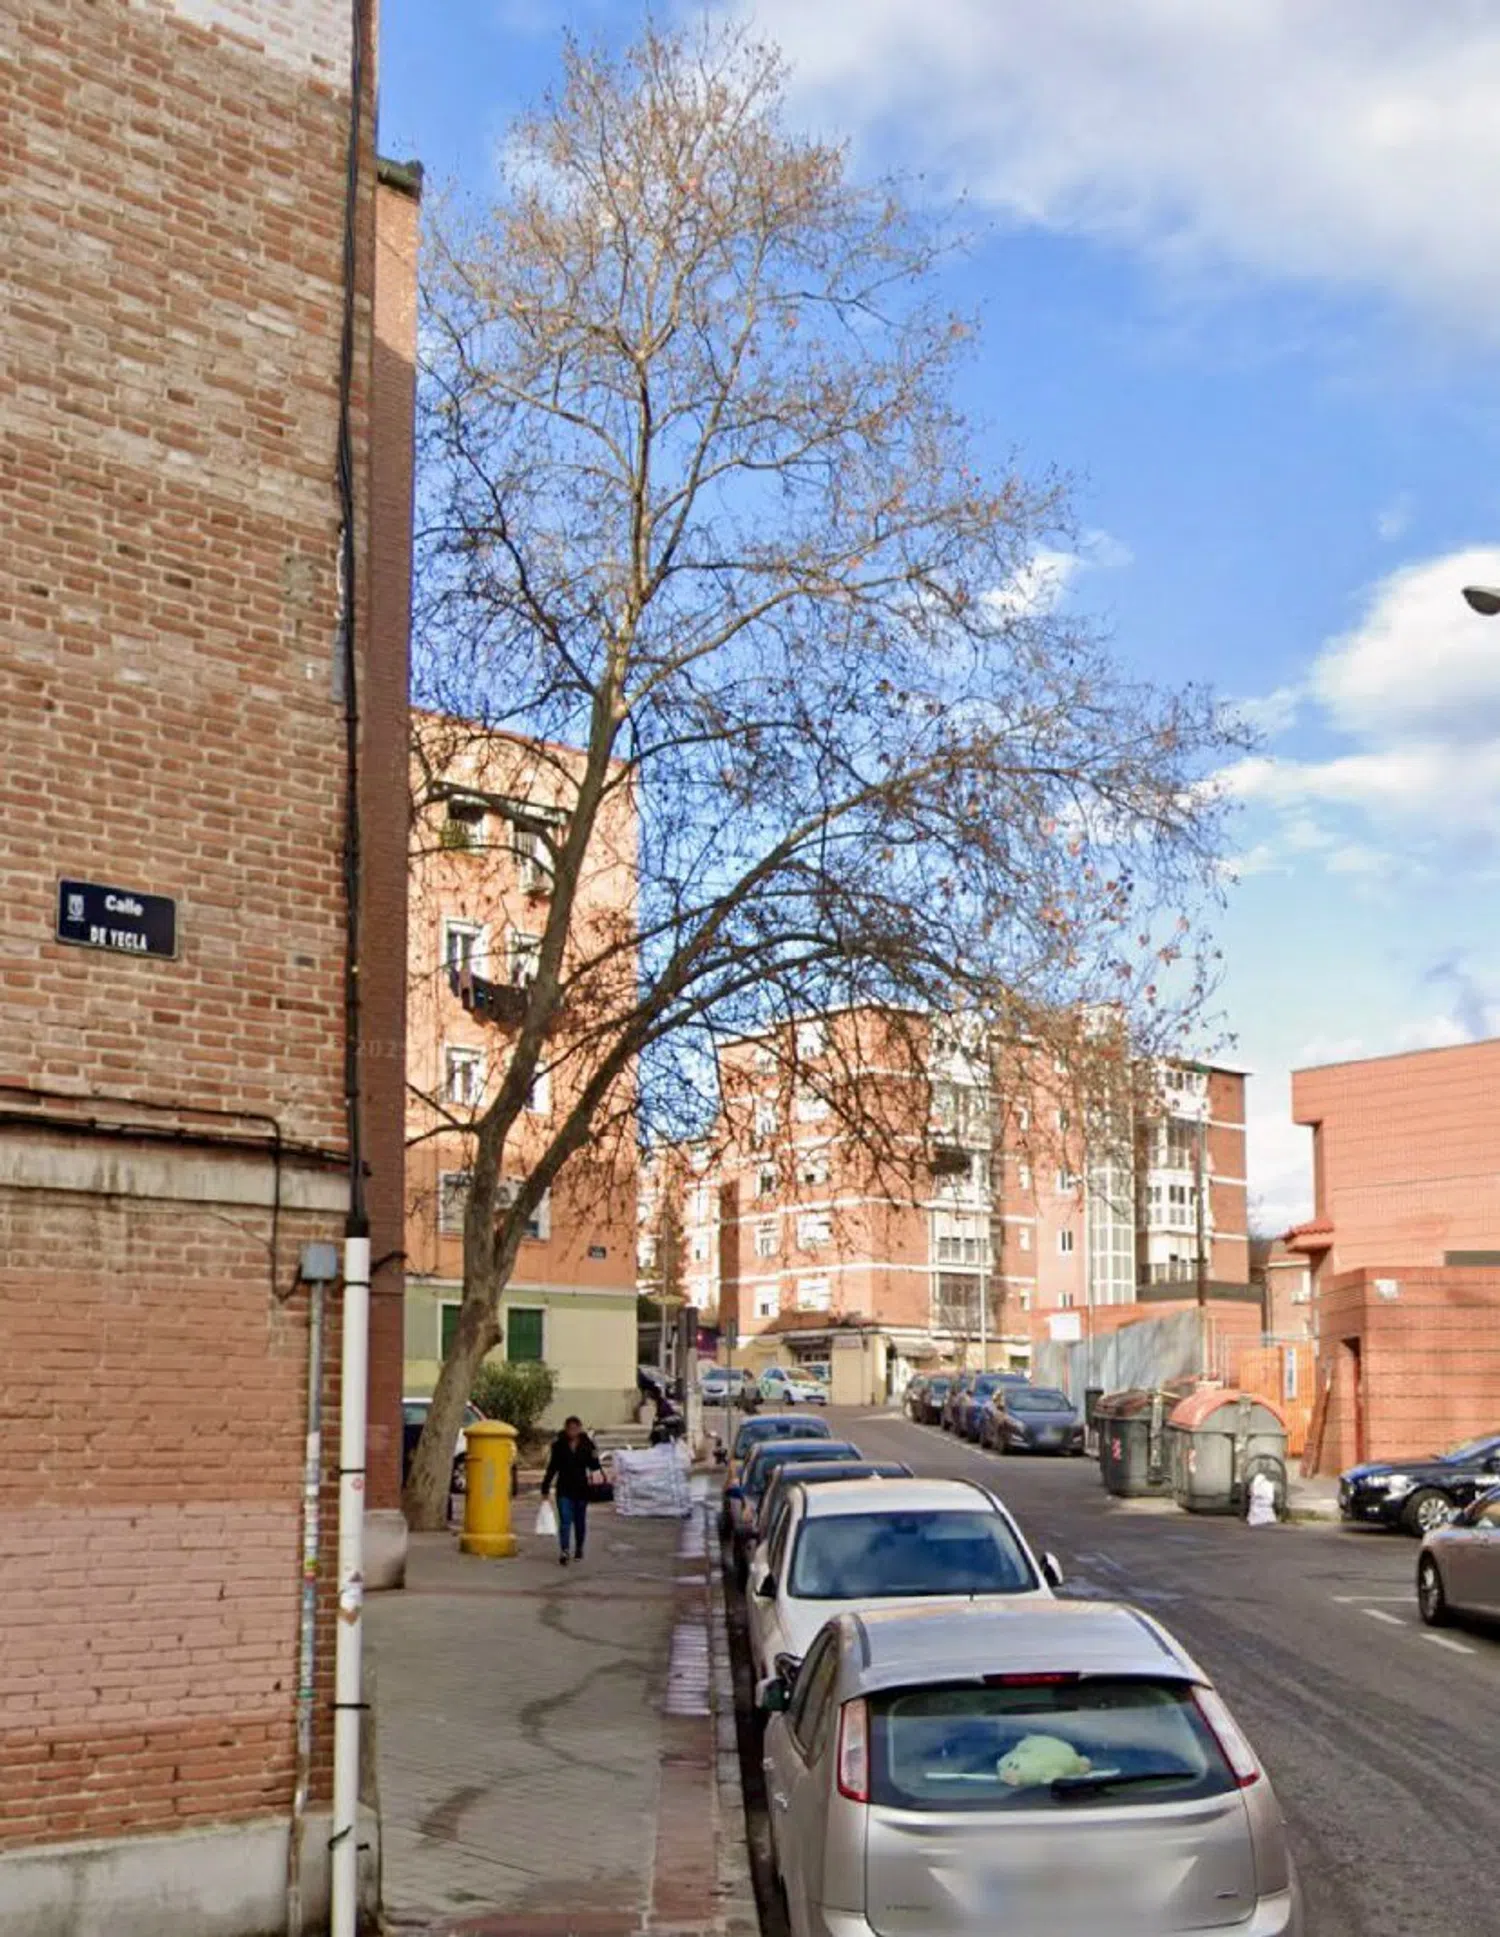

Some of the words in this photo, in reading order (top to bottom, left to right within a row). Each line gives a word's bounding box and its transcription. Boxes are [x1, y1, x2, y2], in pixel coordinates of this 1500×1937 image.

[105, 895, 144, 916] Calle
[90, 925, 107, 945] DE
[110, 929, 148, 950] YECLA
